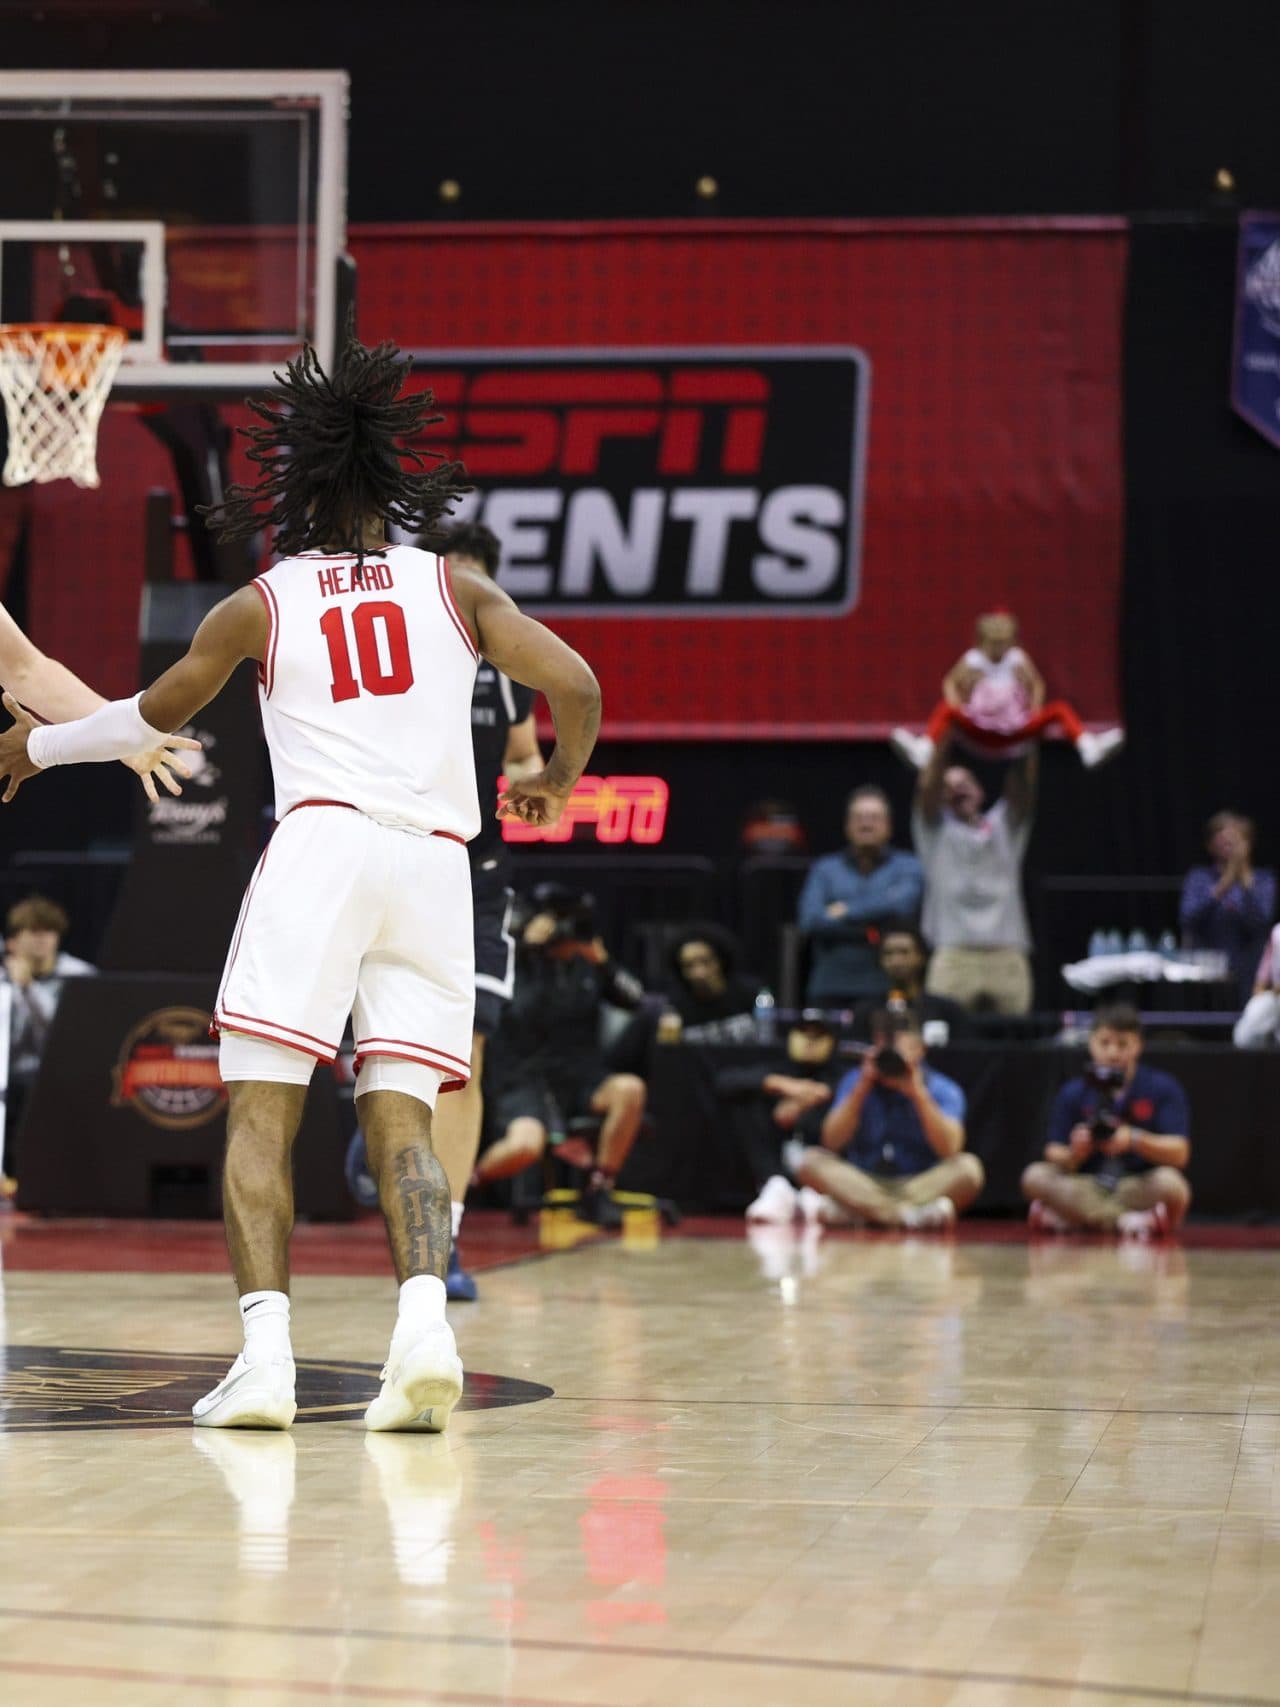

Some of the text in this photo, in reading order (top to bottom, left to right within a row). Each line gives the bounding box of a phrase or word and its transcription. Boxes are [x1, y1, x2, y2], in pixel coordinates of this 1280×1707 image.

[317, 564, 395, 598] HEARD
[392, 486, 845, 598] ENTS
[319, 601, 415, 704] 10
